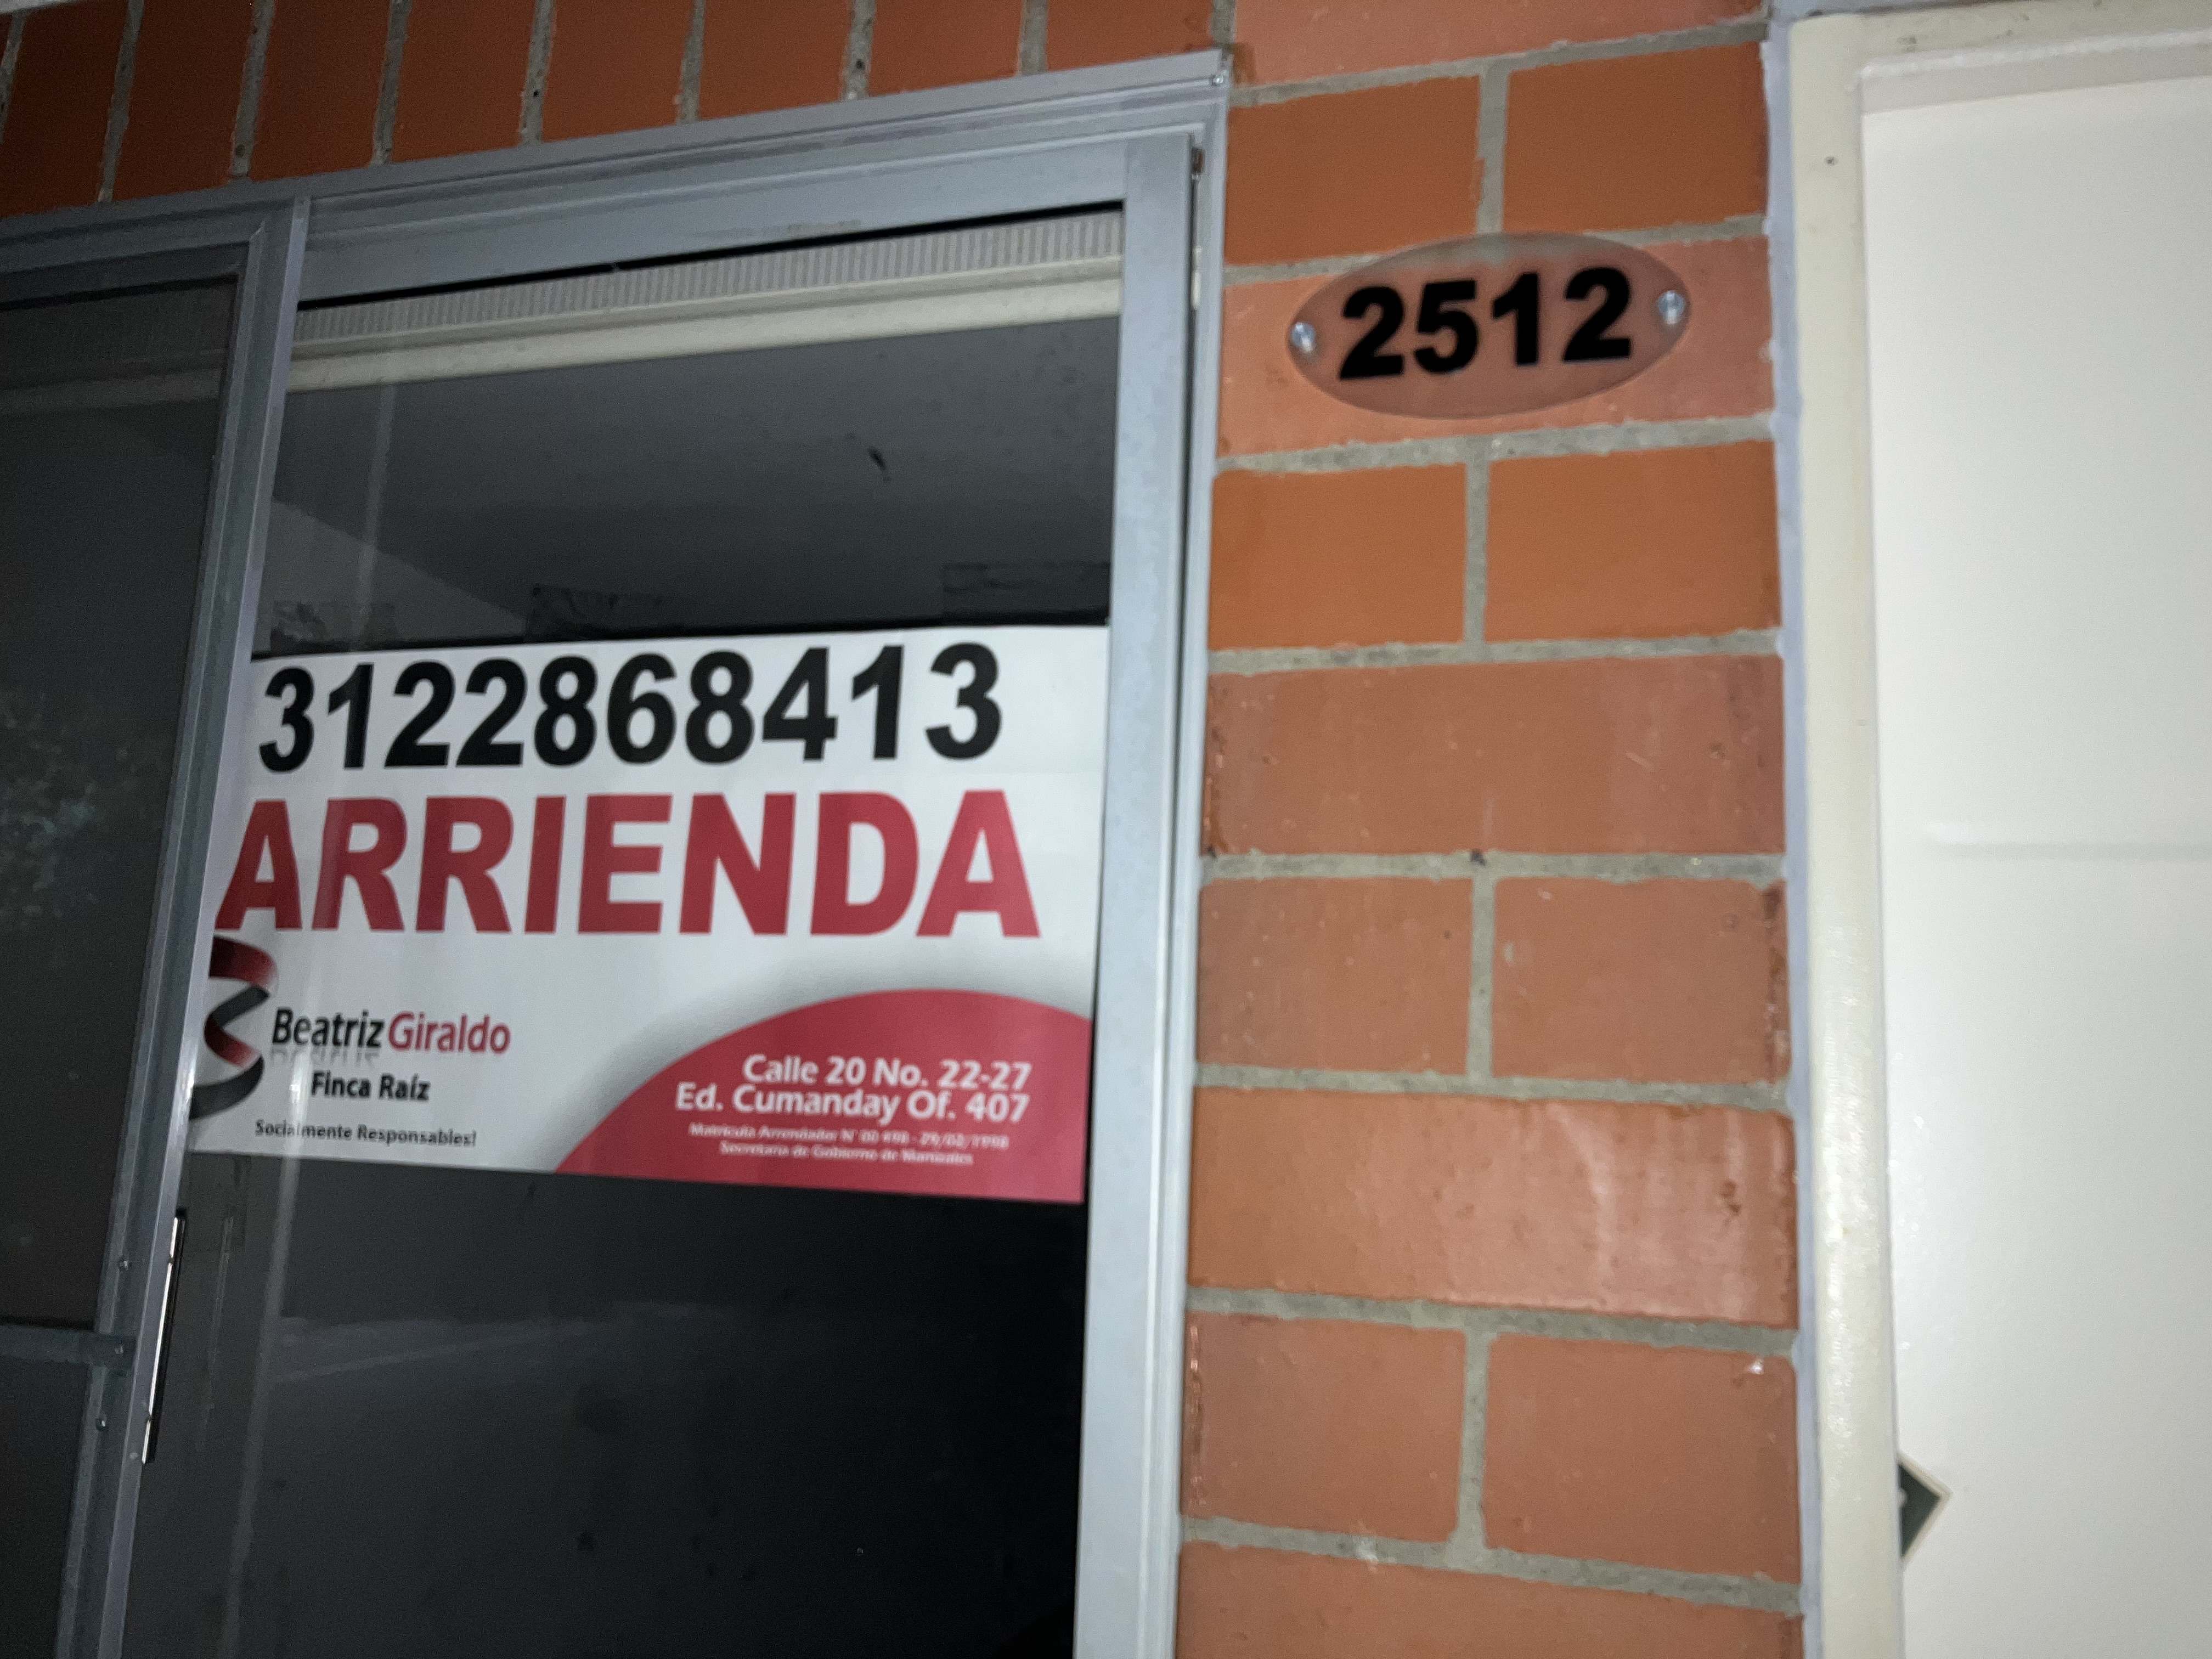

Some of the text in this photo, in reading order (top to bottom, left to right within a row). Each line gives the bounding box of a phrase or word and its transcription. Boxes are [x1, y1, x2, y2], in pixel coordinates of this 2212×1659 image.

[1339, 266, 1632, 380] 2512
[258, 642, 1002, 772] 3122868413
[215, 789, 1041, 939] ARRIENDA
[311, 1071, 371, 1098] Finca
[742, 1053, 1032, 1091] Calle 20 No. 22-27
[675, 1081, 1030, 1127] Ed. Cumanday Of. 407
[255, 1119, 352, 1140] Socialmente
